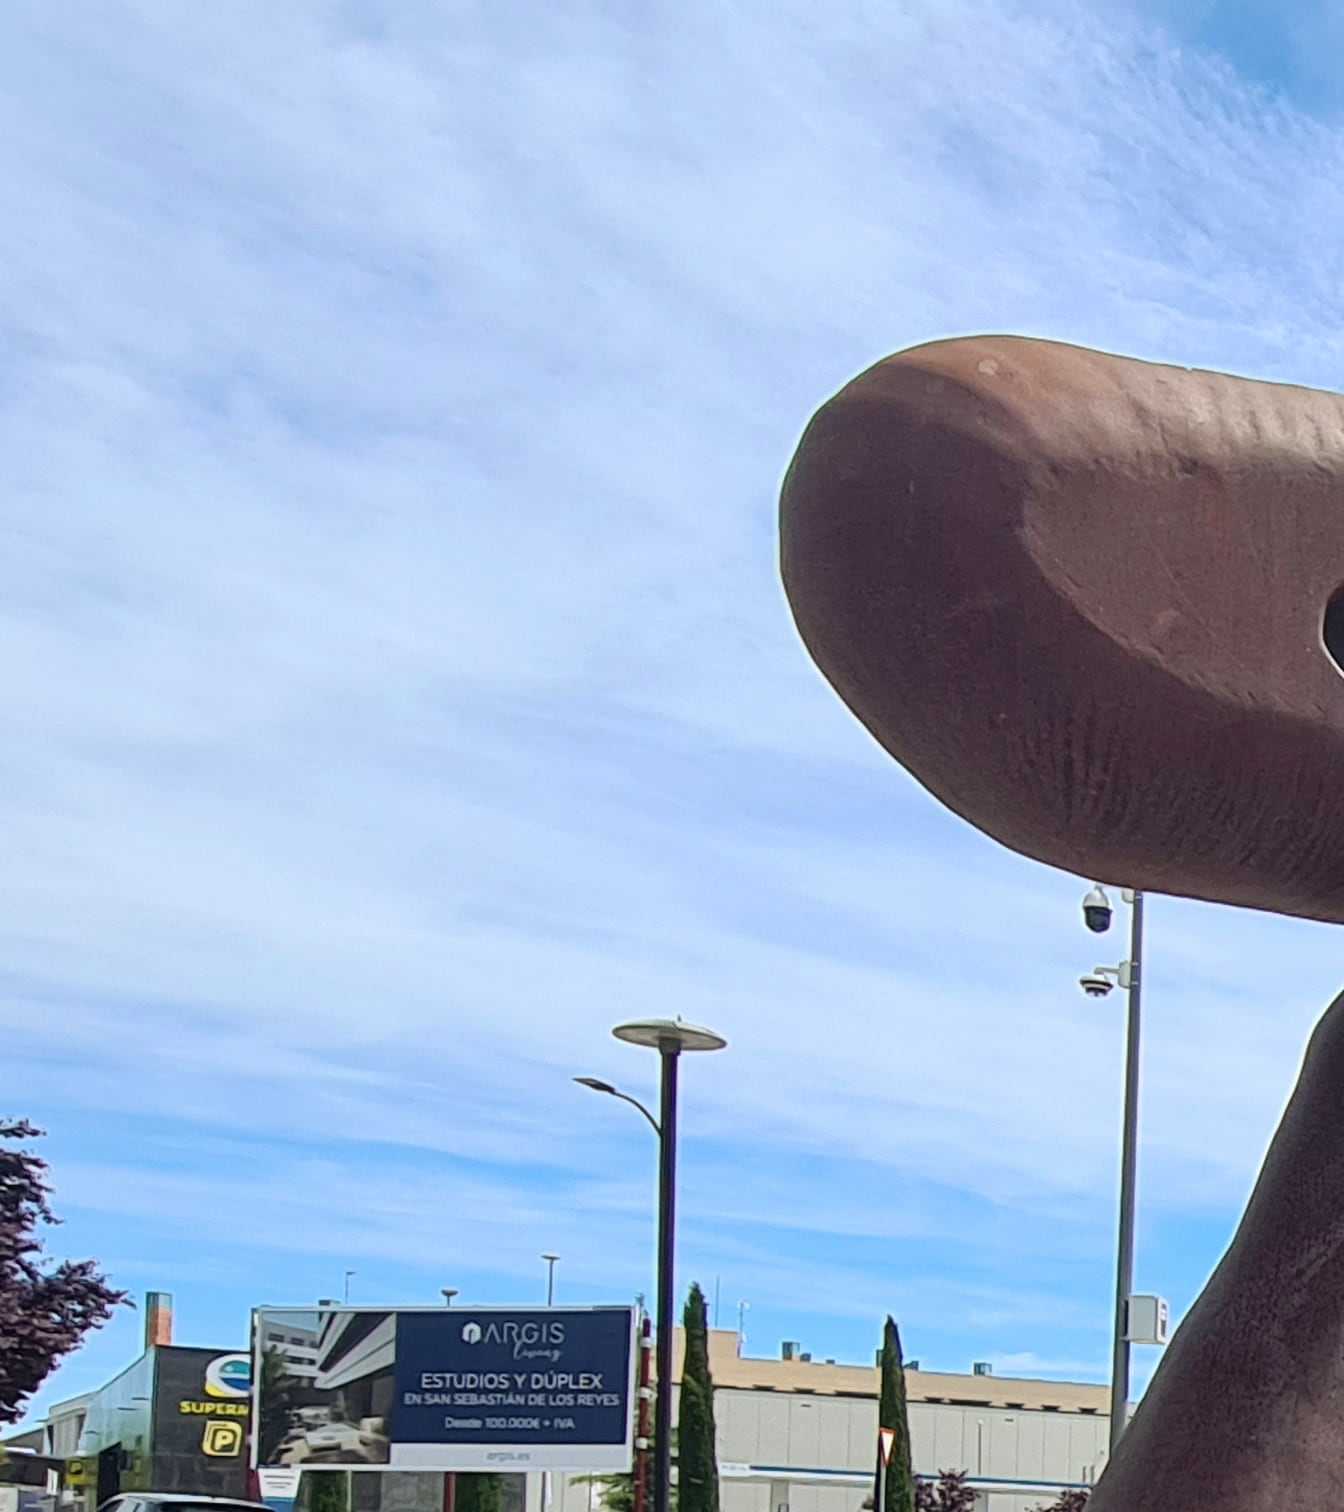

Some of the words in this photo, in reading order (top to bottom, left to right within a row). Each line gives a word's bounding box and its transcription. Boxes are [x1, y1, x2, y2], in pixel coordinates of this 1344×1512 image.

[484, 1322, 565, 1344] ARGIS
[421, 1373, 510, 1389] ESTUDIOS
[513, 1373, 527, 1389] Y
[531, 1370, 603, 1389] DÚPLEX
[404, 1393, 422, 1404] EN
[424, 1393, 451, 1405] SAN
[453, 1392, 525, 1405] SEBASTIÁN
[528, 1394, 546, 1406] DE
[549, 1394, 574, 1406] LOS
[577, 1394, 620, 1406] REYES
